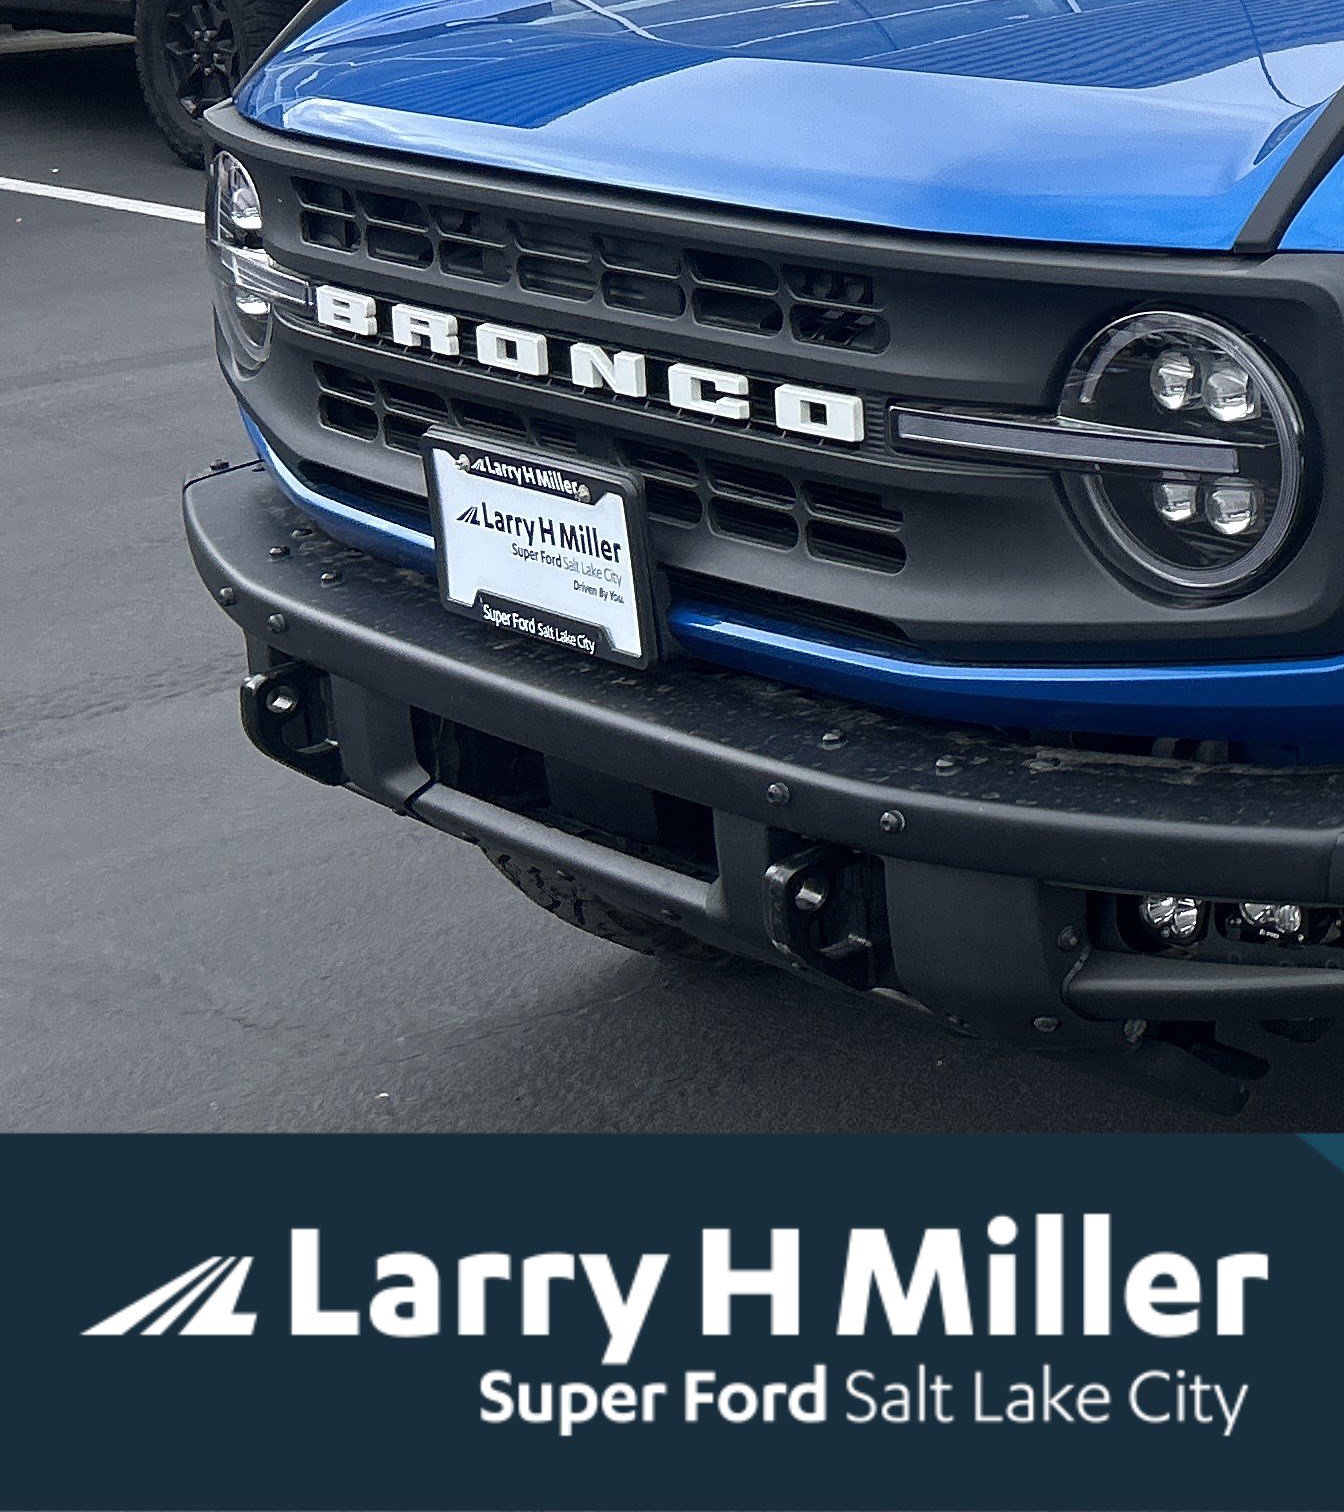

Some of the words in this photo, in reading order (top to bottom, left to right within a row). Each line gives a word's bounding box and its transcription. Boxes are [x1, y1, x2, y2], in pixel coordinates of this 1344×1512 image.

[316, 285, 864, 443] BRONCO
[484, 456, 521, 485] Larry
[522, 465, 536, 485] H
[535, 468, 578, 494] Miller
[482, 501, 535, 546] Larry
[538, 516, 555, 546] H
[559, 522, 621, 564] Miller
[512, 542, 538, 562] Super
[540, 550, 562, 568] Ford
[563, 556, 580, 573] Salt
[581, 560, 603, 579] Lake
[603, 567, 622, 588] City
[483, 604, 511, 627] Super
[511, 612, 536, 634] Ford
[537, 622, 555, 640] Salt
[555, 628, 577, 647] Lake
[577, 634, 595, 655] City
